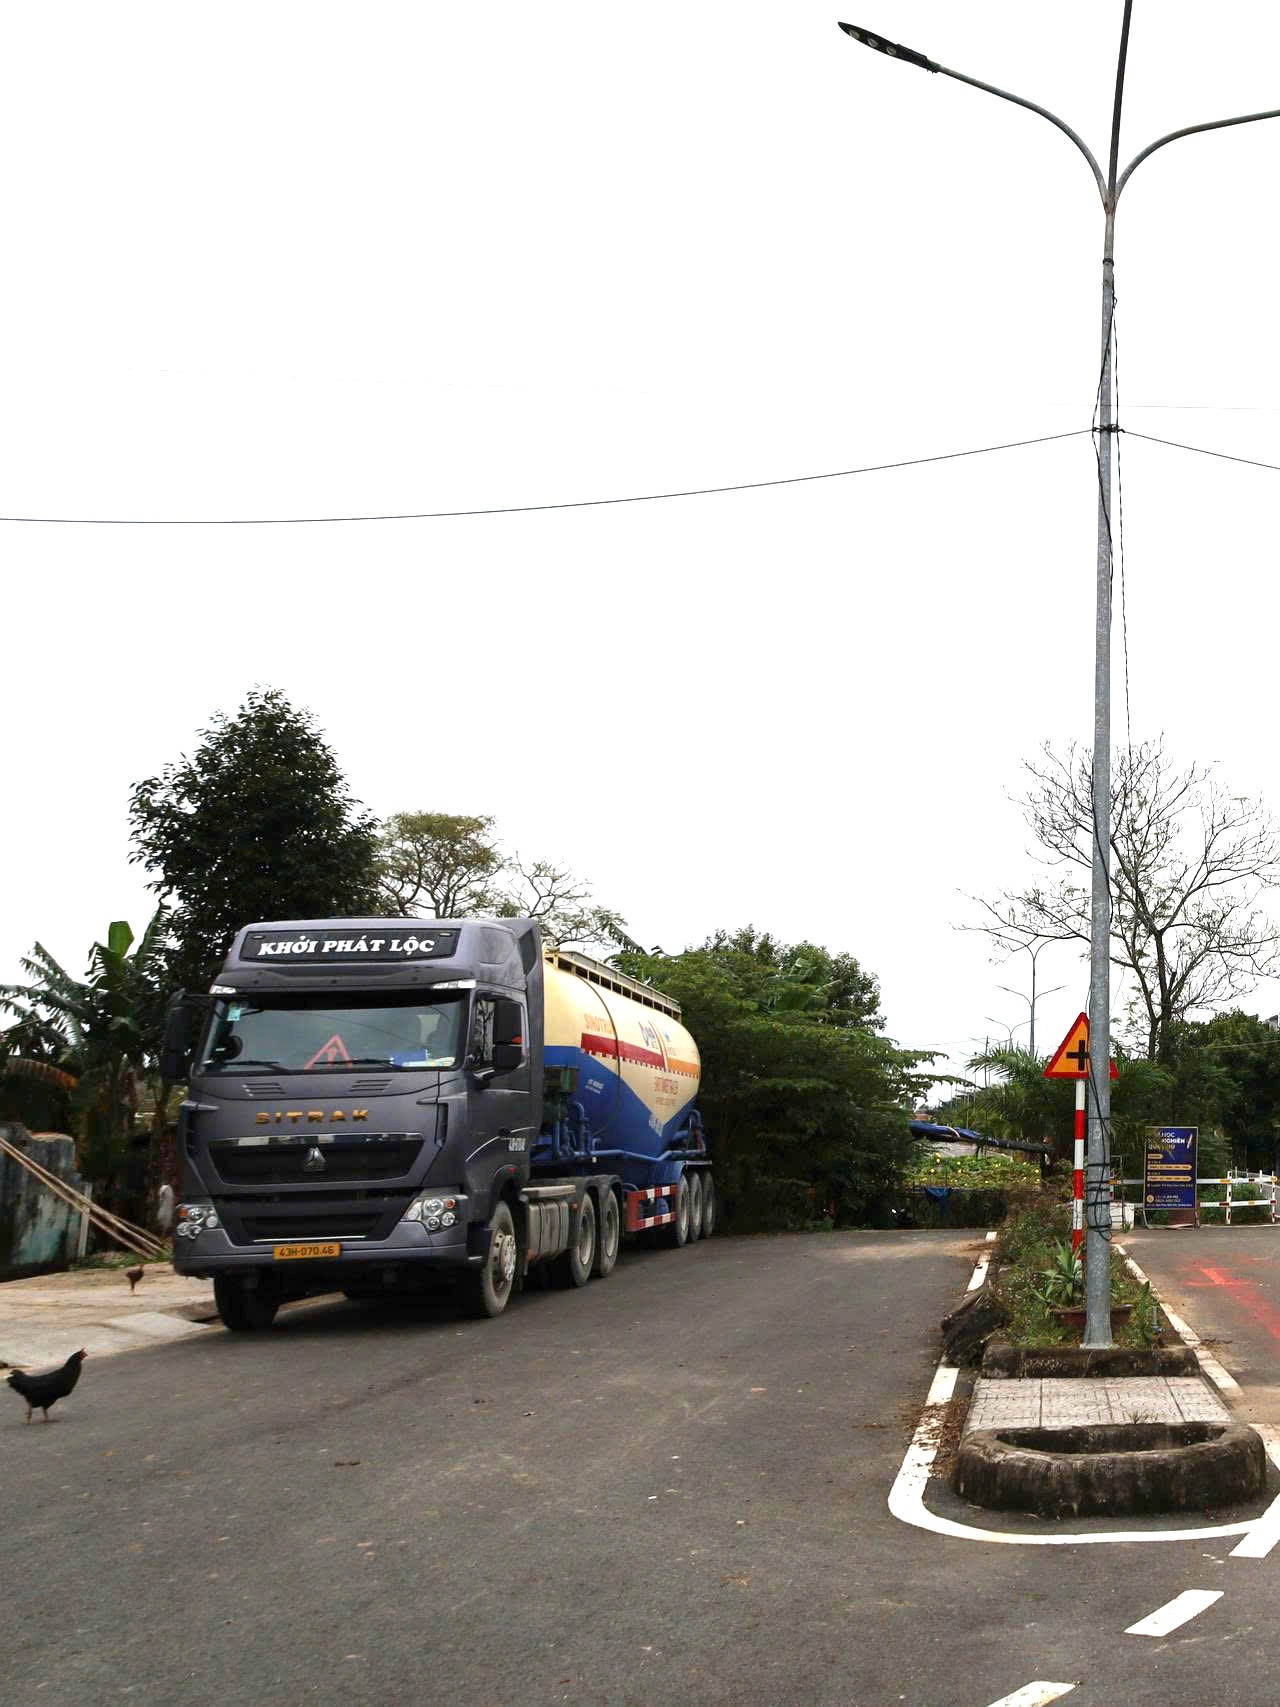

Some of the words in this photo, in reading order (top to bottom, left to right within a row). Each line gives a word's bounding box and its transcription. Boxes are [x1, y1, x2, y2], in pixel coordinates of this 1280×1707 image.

[257, 935, 320, 956] KHỞI
[321, 935, 387, 953] PHÁT
[388, 936, 436, 956] LỘC
[255, 1108, 369, 1124] SITRAK
